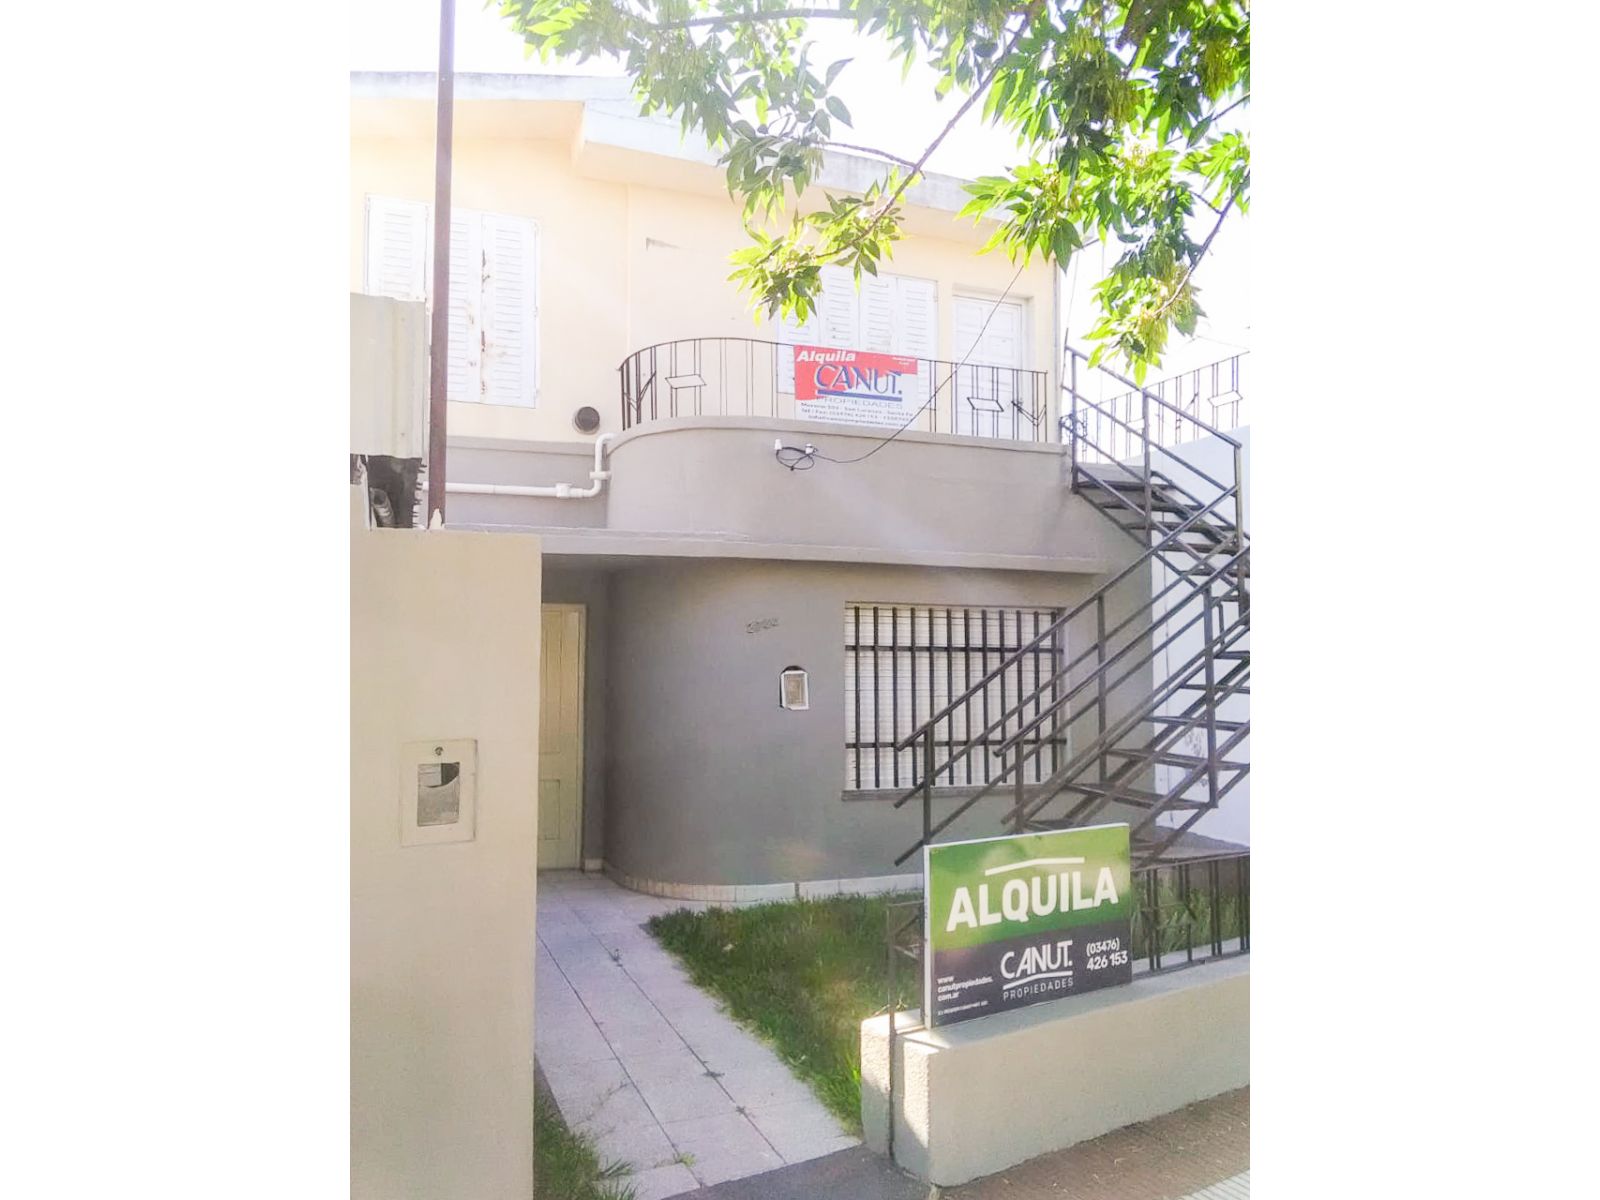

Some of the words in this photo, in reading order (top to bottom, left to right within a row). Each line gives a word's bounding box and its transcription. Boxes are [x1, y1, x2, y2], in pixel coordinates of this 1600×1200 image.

[797, 350, 856, 364] Alquila
[814, 363, 903, 395] CANUT.
[815, 396, 903, 410] PROPIEDADES
[946, 867, 1119, 932] ALQUILA
[1086, 937, 1120, 957] (03476)
[1000, 940, 1073, 979] CANUT.
[1087, 954, 1108, 971] 426
[1109, 950, 1128, 967] 153
[937, 976, 954, 984] www
[1003, 977, 1074, 1001] PROPIEDADES
[937, 991, 960, 1002] com.ar
